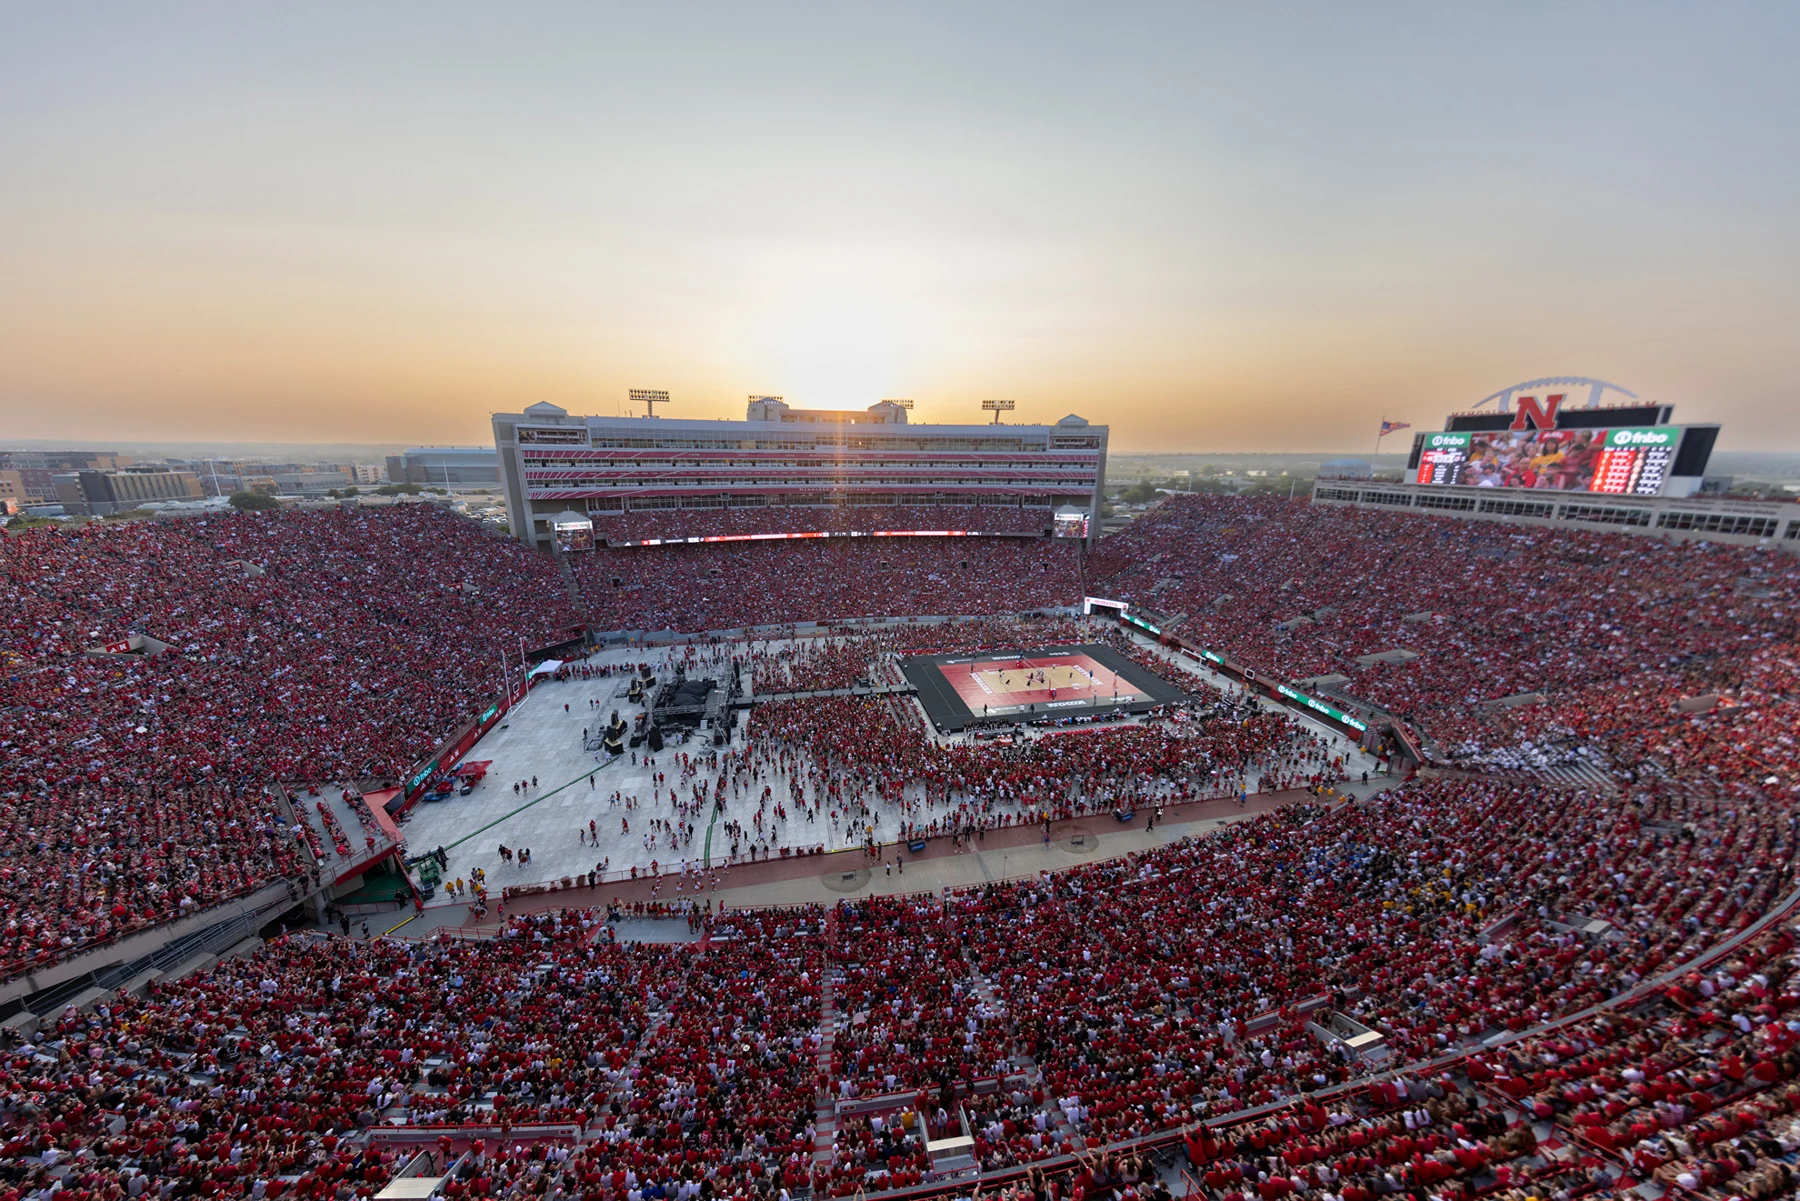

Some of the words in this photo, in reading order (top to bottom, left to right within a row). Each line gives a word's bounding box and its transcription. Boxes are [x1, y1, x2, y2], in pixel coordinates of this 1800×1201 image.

[1510, 394, 1565, 430] N
[1631, 432, 1669, 443] fnbo
[1348, 718, 1366, 731] fnbo
